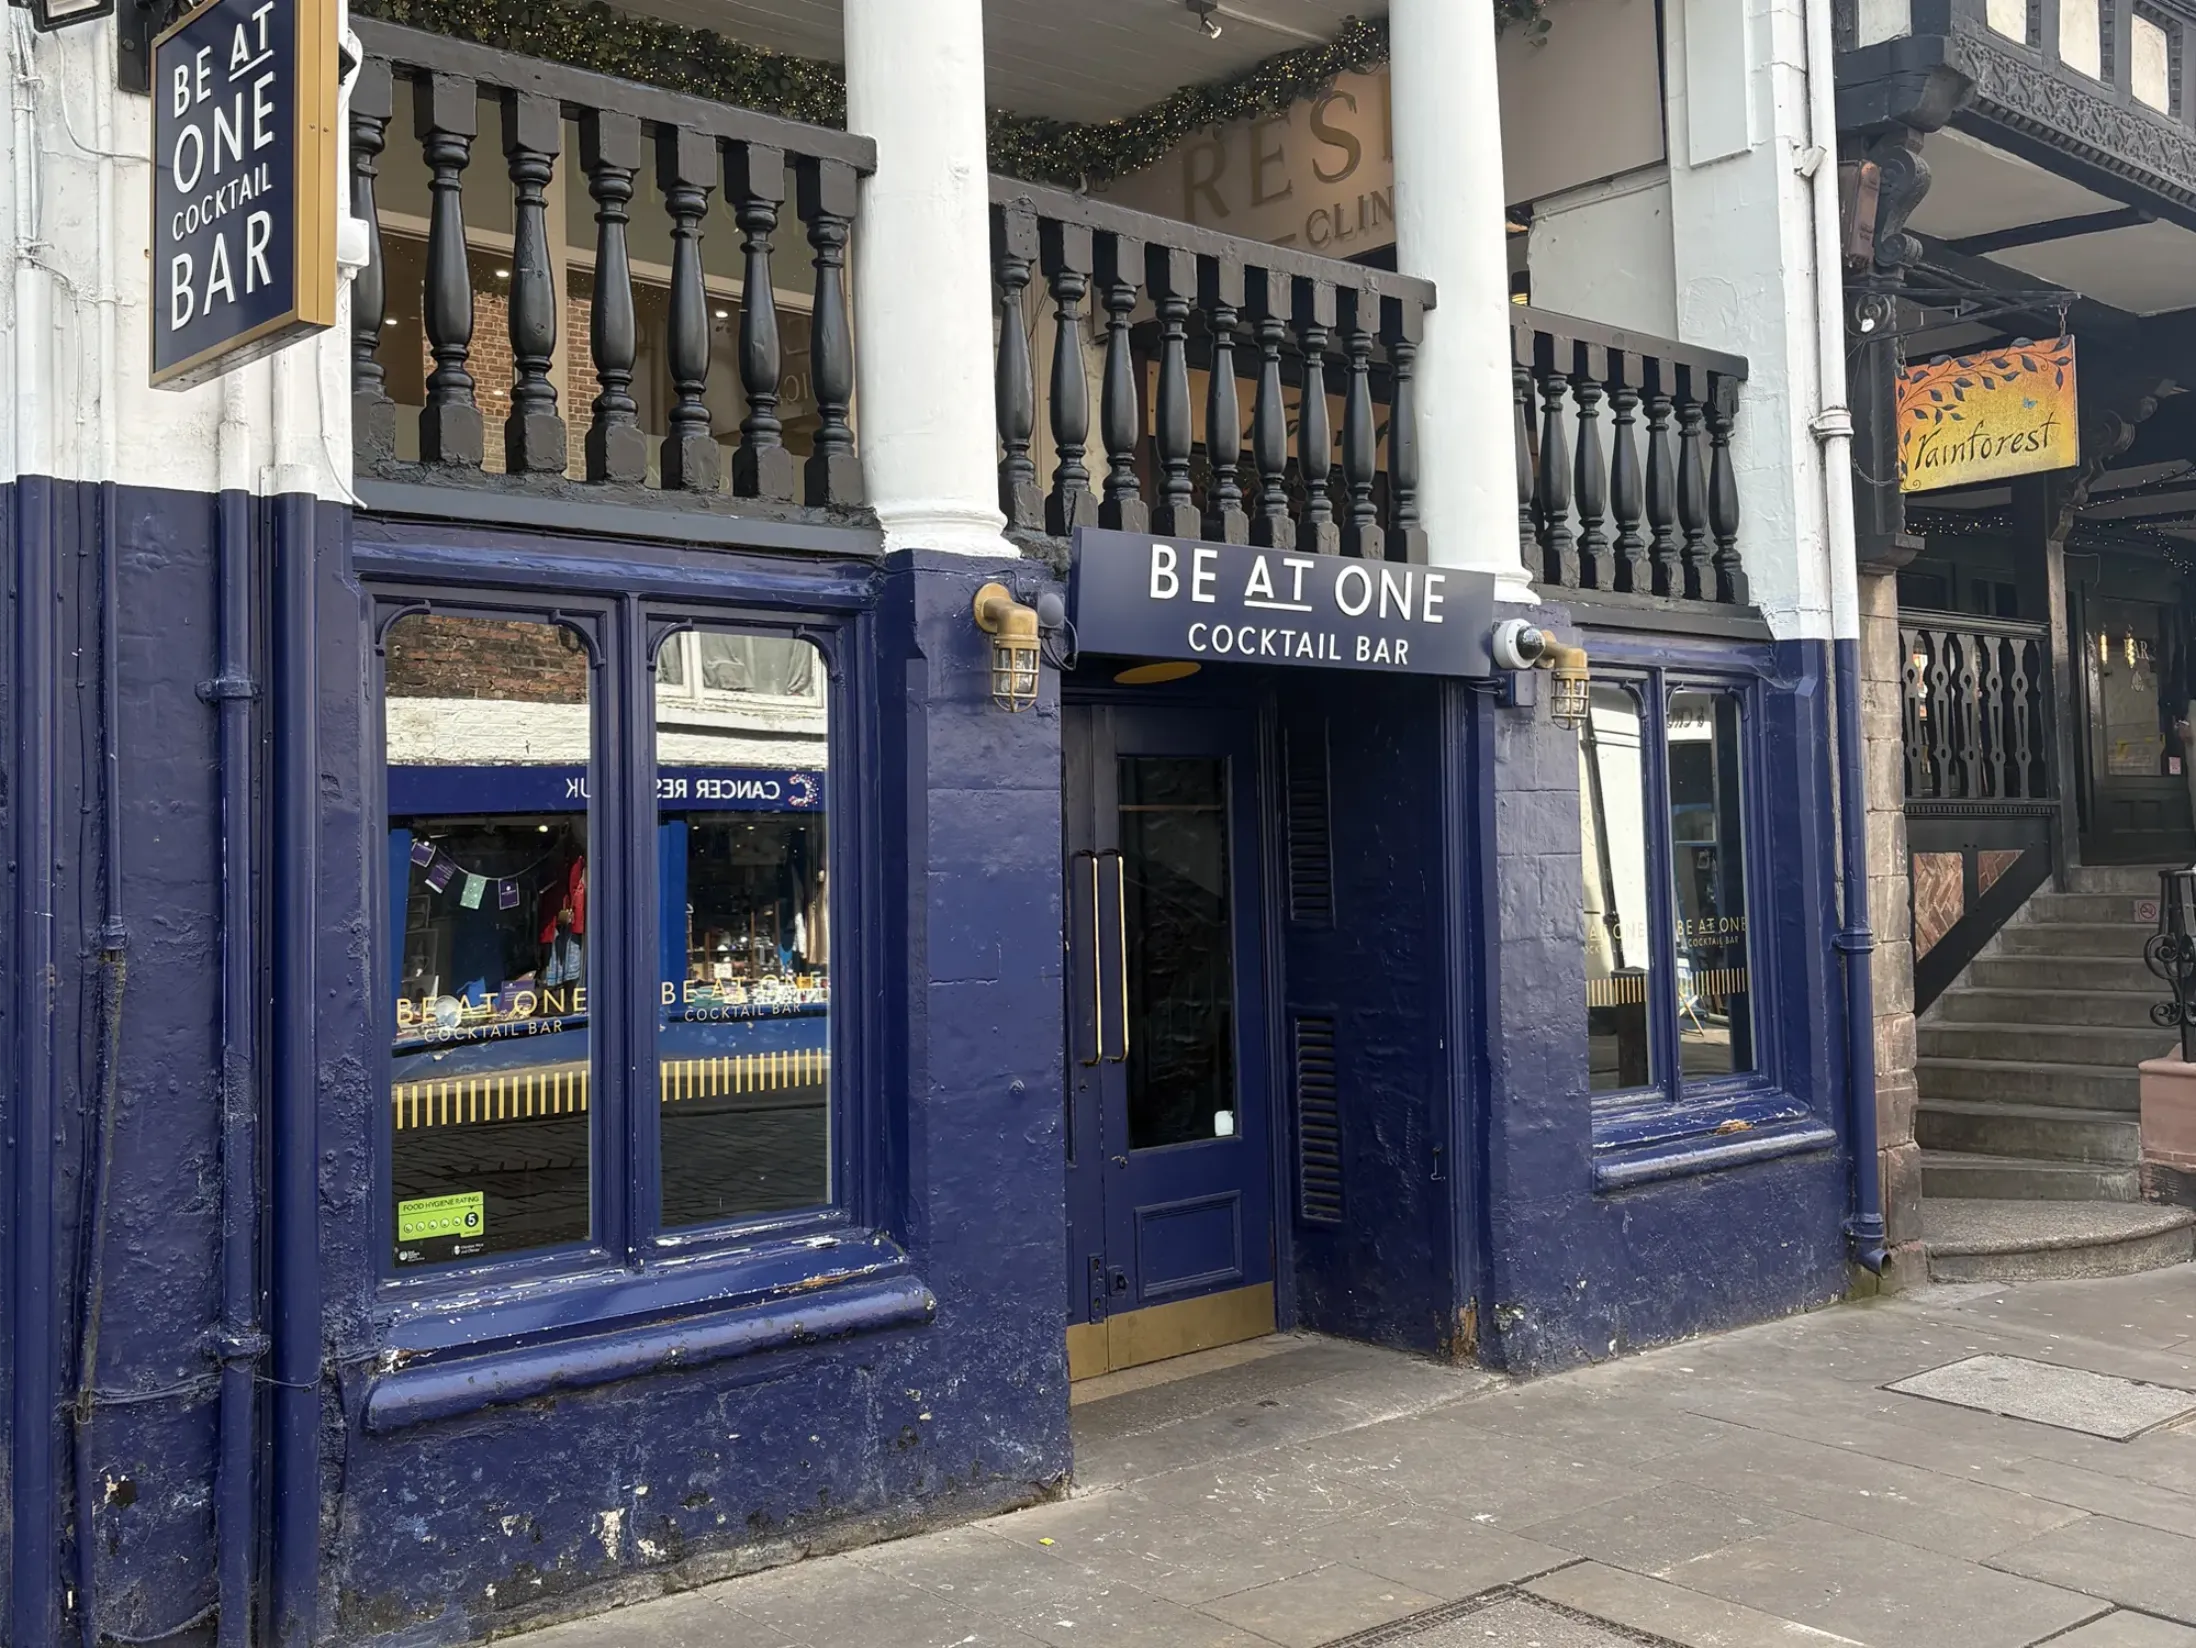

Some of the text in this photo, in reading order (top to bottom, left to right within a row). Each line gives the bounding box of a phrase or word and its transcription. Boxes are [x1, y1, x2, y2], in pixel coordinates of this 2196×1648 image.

[174, 0, 276, 119] BE AT
[173, 71, 276, 193] ONE
[172, 162, 273, 242] COCKTAIL
[172, 210, 272, 332] BAR
[1150, 543, 1446, 623] BE AT ONE
[1188, 622, 1409, 665] COCKTAIL BAR
[1677, 916, 1747, 936] BE AT ONE
[396, 996, 437, 1026] BE
[458, 992, 499, 1016] AT
[511, 987, 587, 1015] ONE
[661, 979, 697, 1005] BE
[684, 1001, 801, 1022] COCKTAIL BAR
[424, 1019, 563, 1043] COCKTAIL BAR
[403, 1195, 480, 1212] FOOD HYGIENE RATING
[467, 1213, 476, 1226] 5
